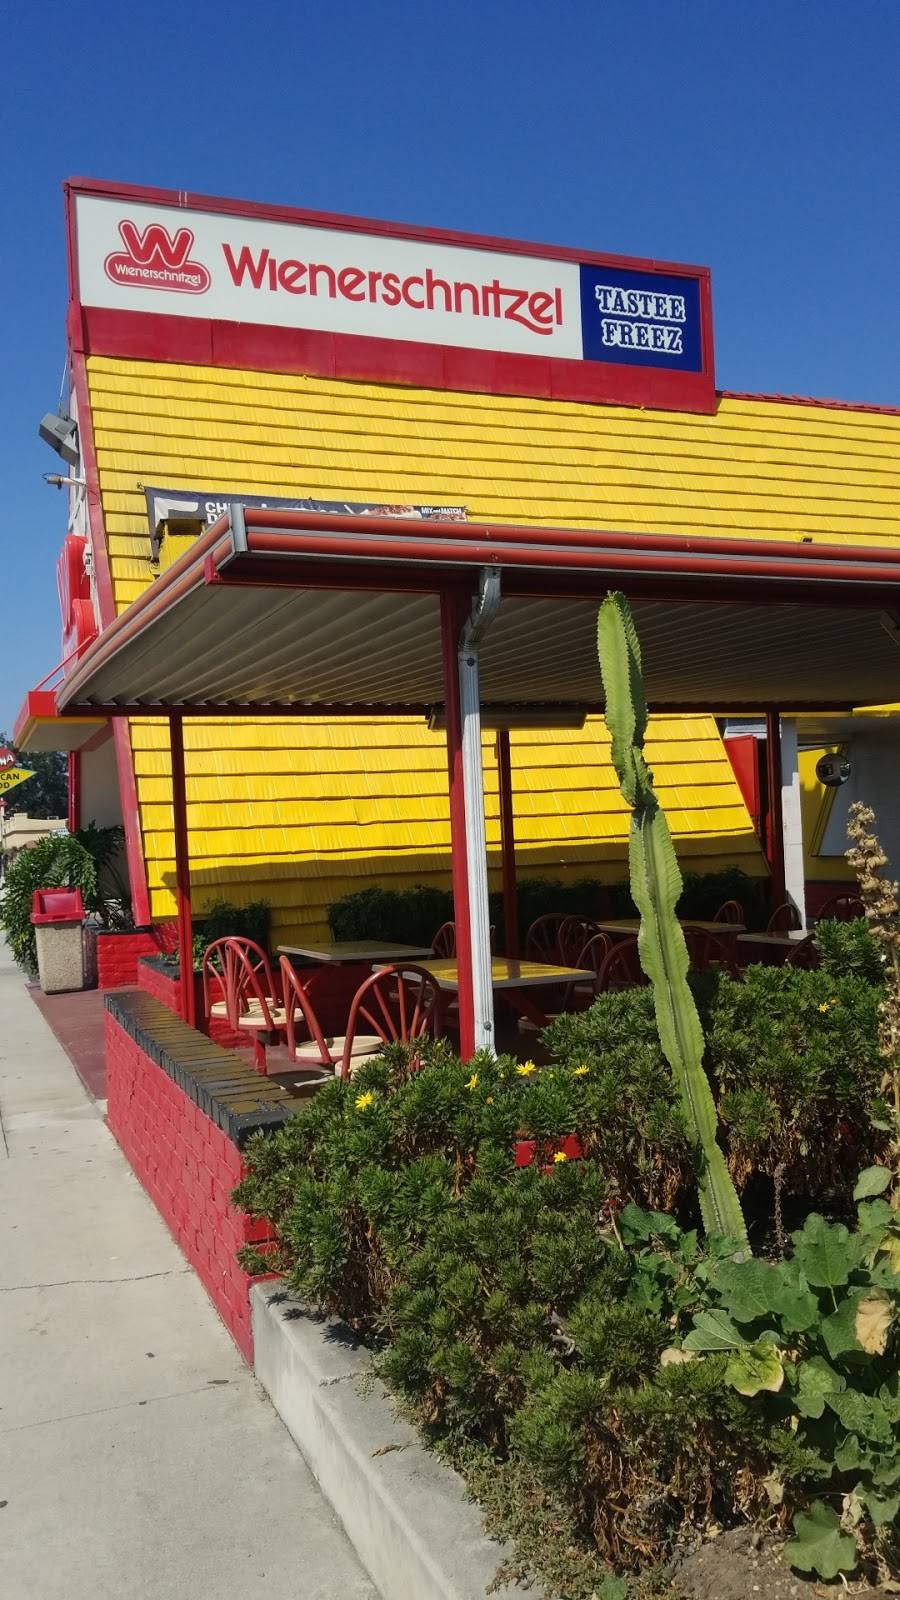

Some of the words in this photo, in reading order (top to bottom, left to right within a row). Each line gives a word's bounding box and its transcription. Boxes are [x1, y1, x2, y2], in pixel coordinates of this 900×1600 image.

[114, 263, 201, 286] Wienerschnitzel
[221, 243, 563, 335] Wienerschnitzel
[595, 285, 686, 323] TASTEE
[601, 318, 683, 354] FREEZ
[421, 506, 433, 514] MIX
